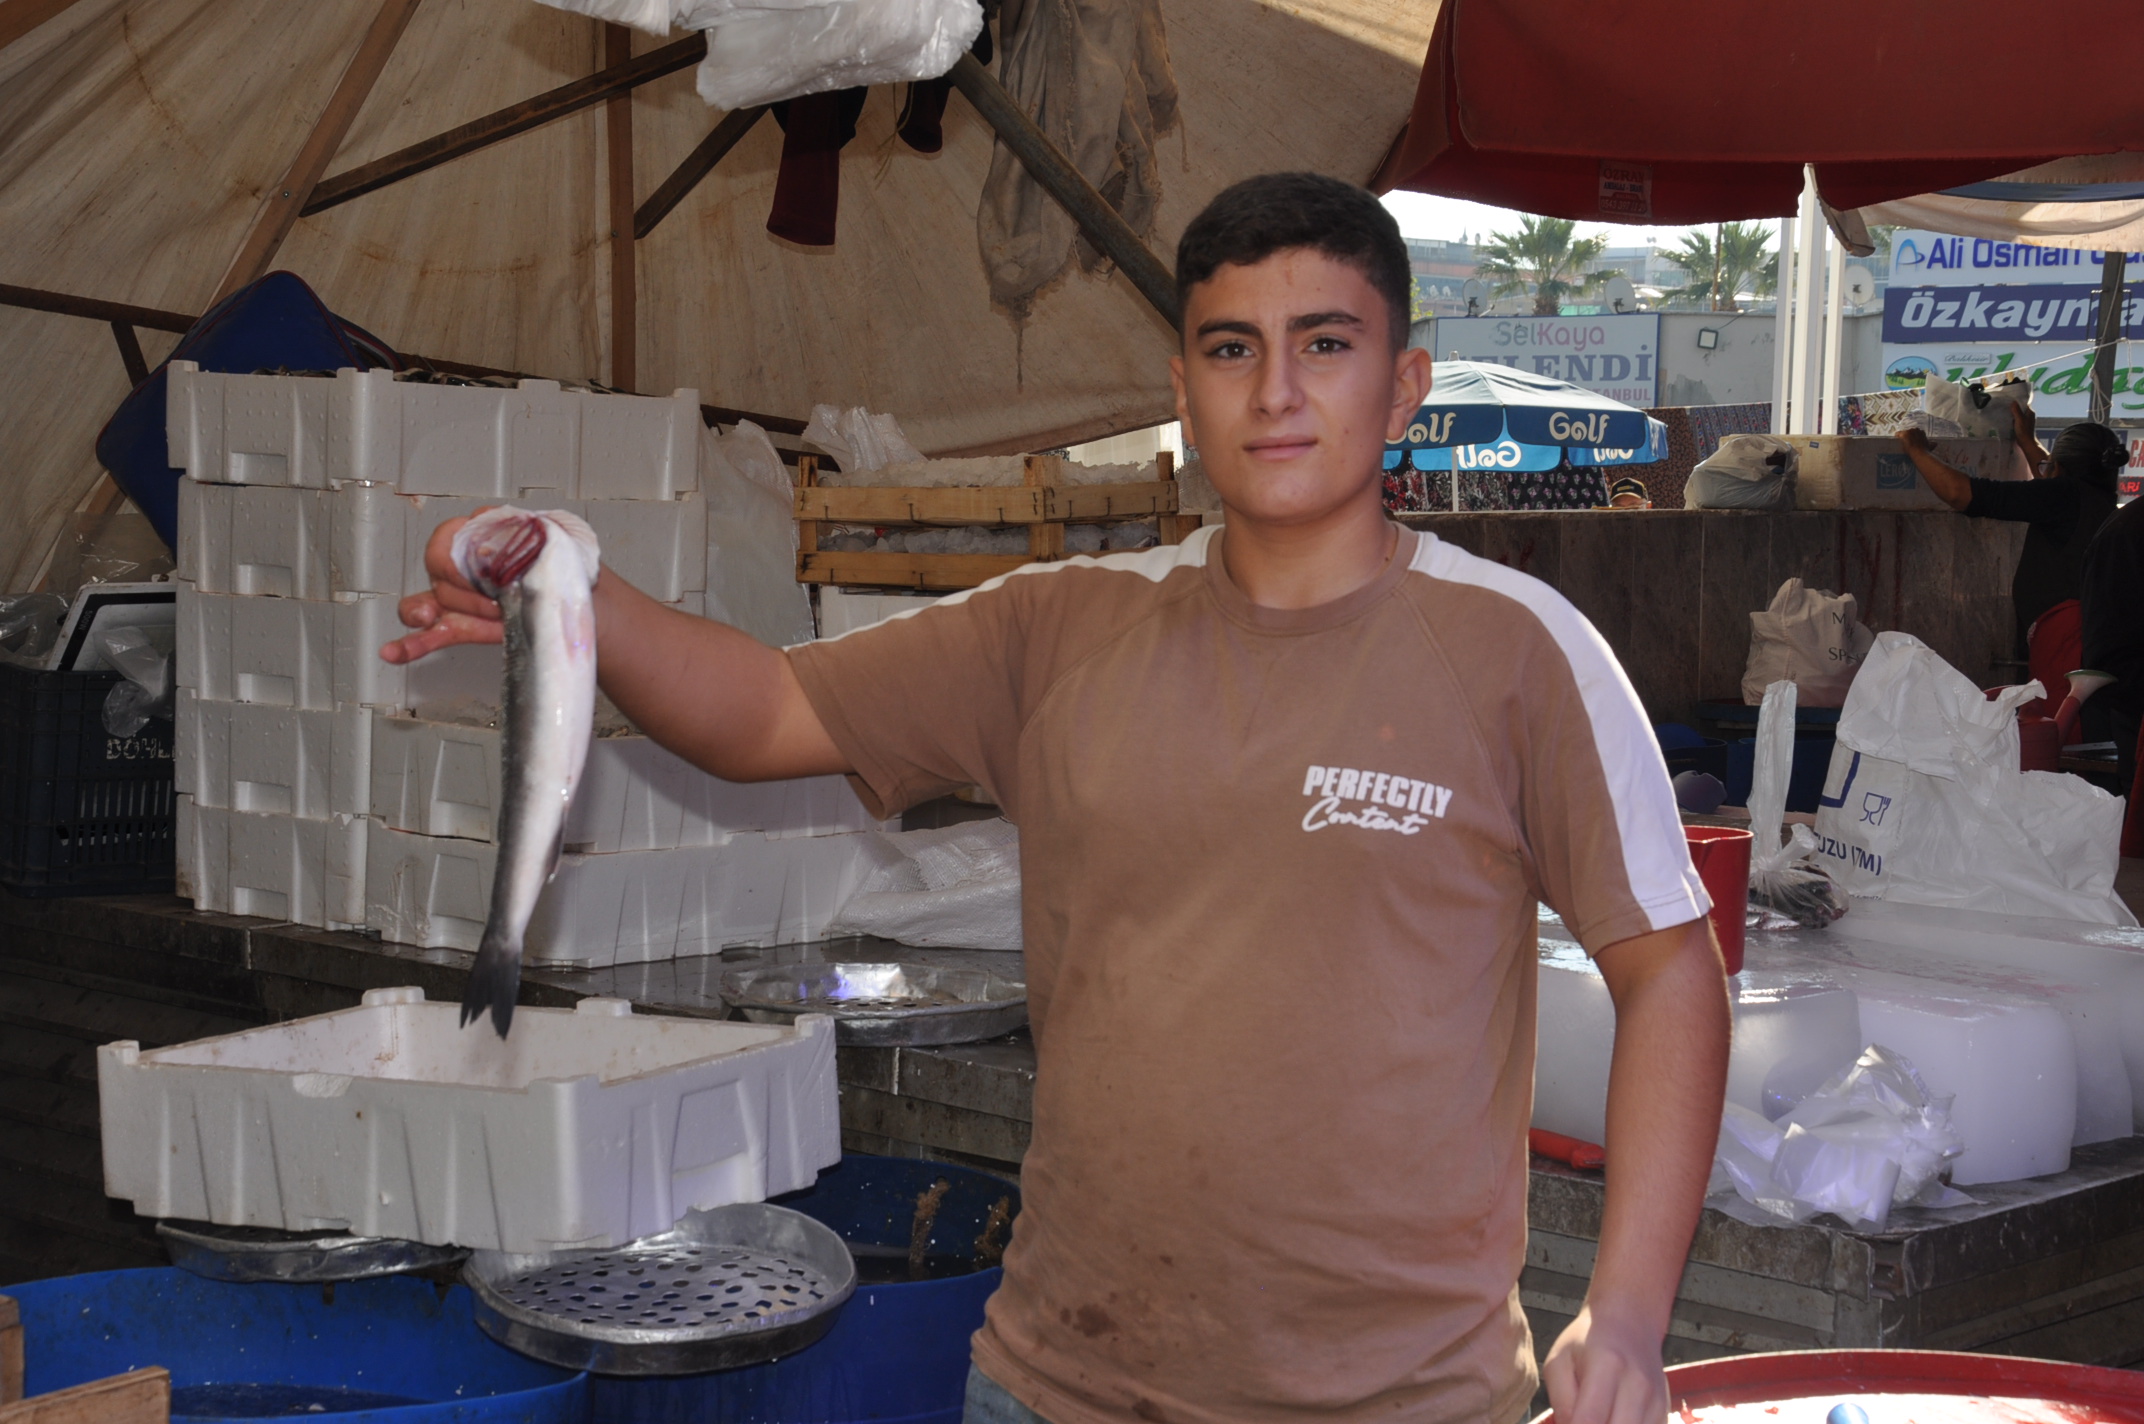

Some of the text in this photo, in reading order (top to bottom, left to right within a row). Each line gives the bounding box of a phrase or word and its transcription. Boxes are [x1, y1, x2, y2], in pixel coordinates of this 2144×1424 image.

[1926, 237, 1964, 269] Ali
[1972, 239, 2081, 268] Osman
[1488, 320, 1605, 351] SelKaya
[1385, 412, 1457, 444] olf
[1549, 411, 1611, 444] Golf
[1302, 765, 1453, 819] PERFECTLY
[1302, 796, 1429, 836] Content
